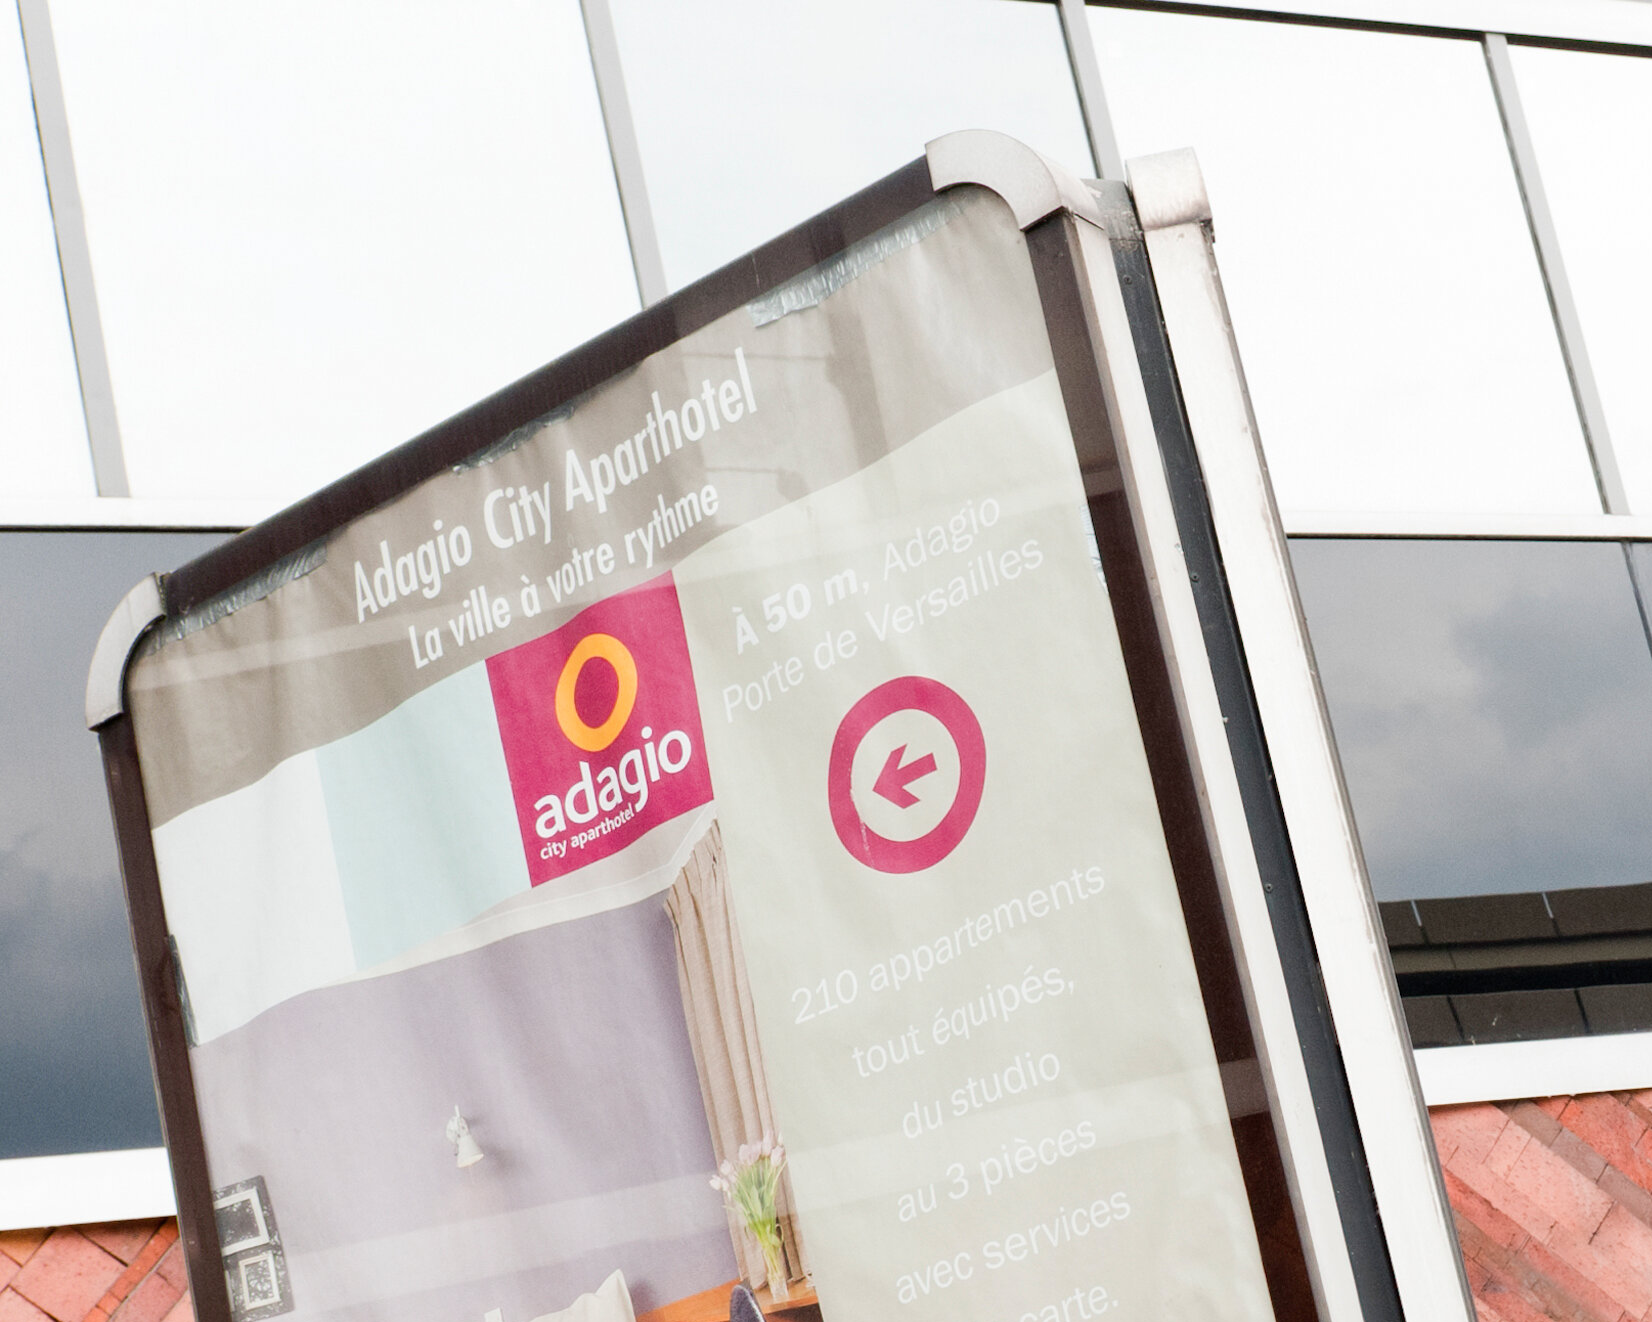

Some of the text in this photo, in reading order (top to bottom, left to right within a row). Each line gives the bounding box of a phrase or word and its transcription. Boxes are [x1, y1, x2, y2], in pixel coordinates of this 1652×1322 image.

[353, 346, 758, 623] Adagio City Aparthotel
[408, 483, 720, 670] La ville à votre rythme
[722, 539, 1044, 723] Porte de Versailles
[731, 498, 1000, 656] À 50 m, Adagio
[534, 726, 692, 839] adagio
[540, 802, 635, 860] city aparthotel
[791, 865, 1106, 1026] 210 appartements
[851, 964, 1076, 1078] tout équipés,
[901, 1050, 1061, 1139] du studio
[897, 1119, 1097, 1223] au 3 pièces
[895, 1191, 1132, 1305] avec services
